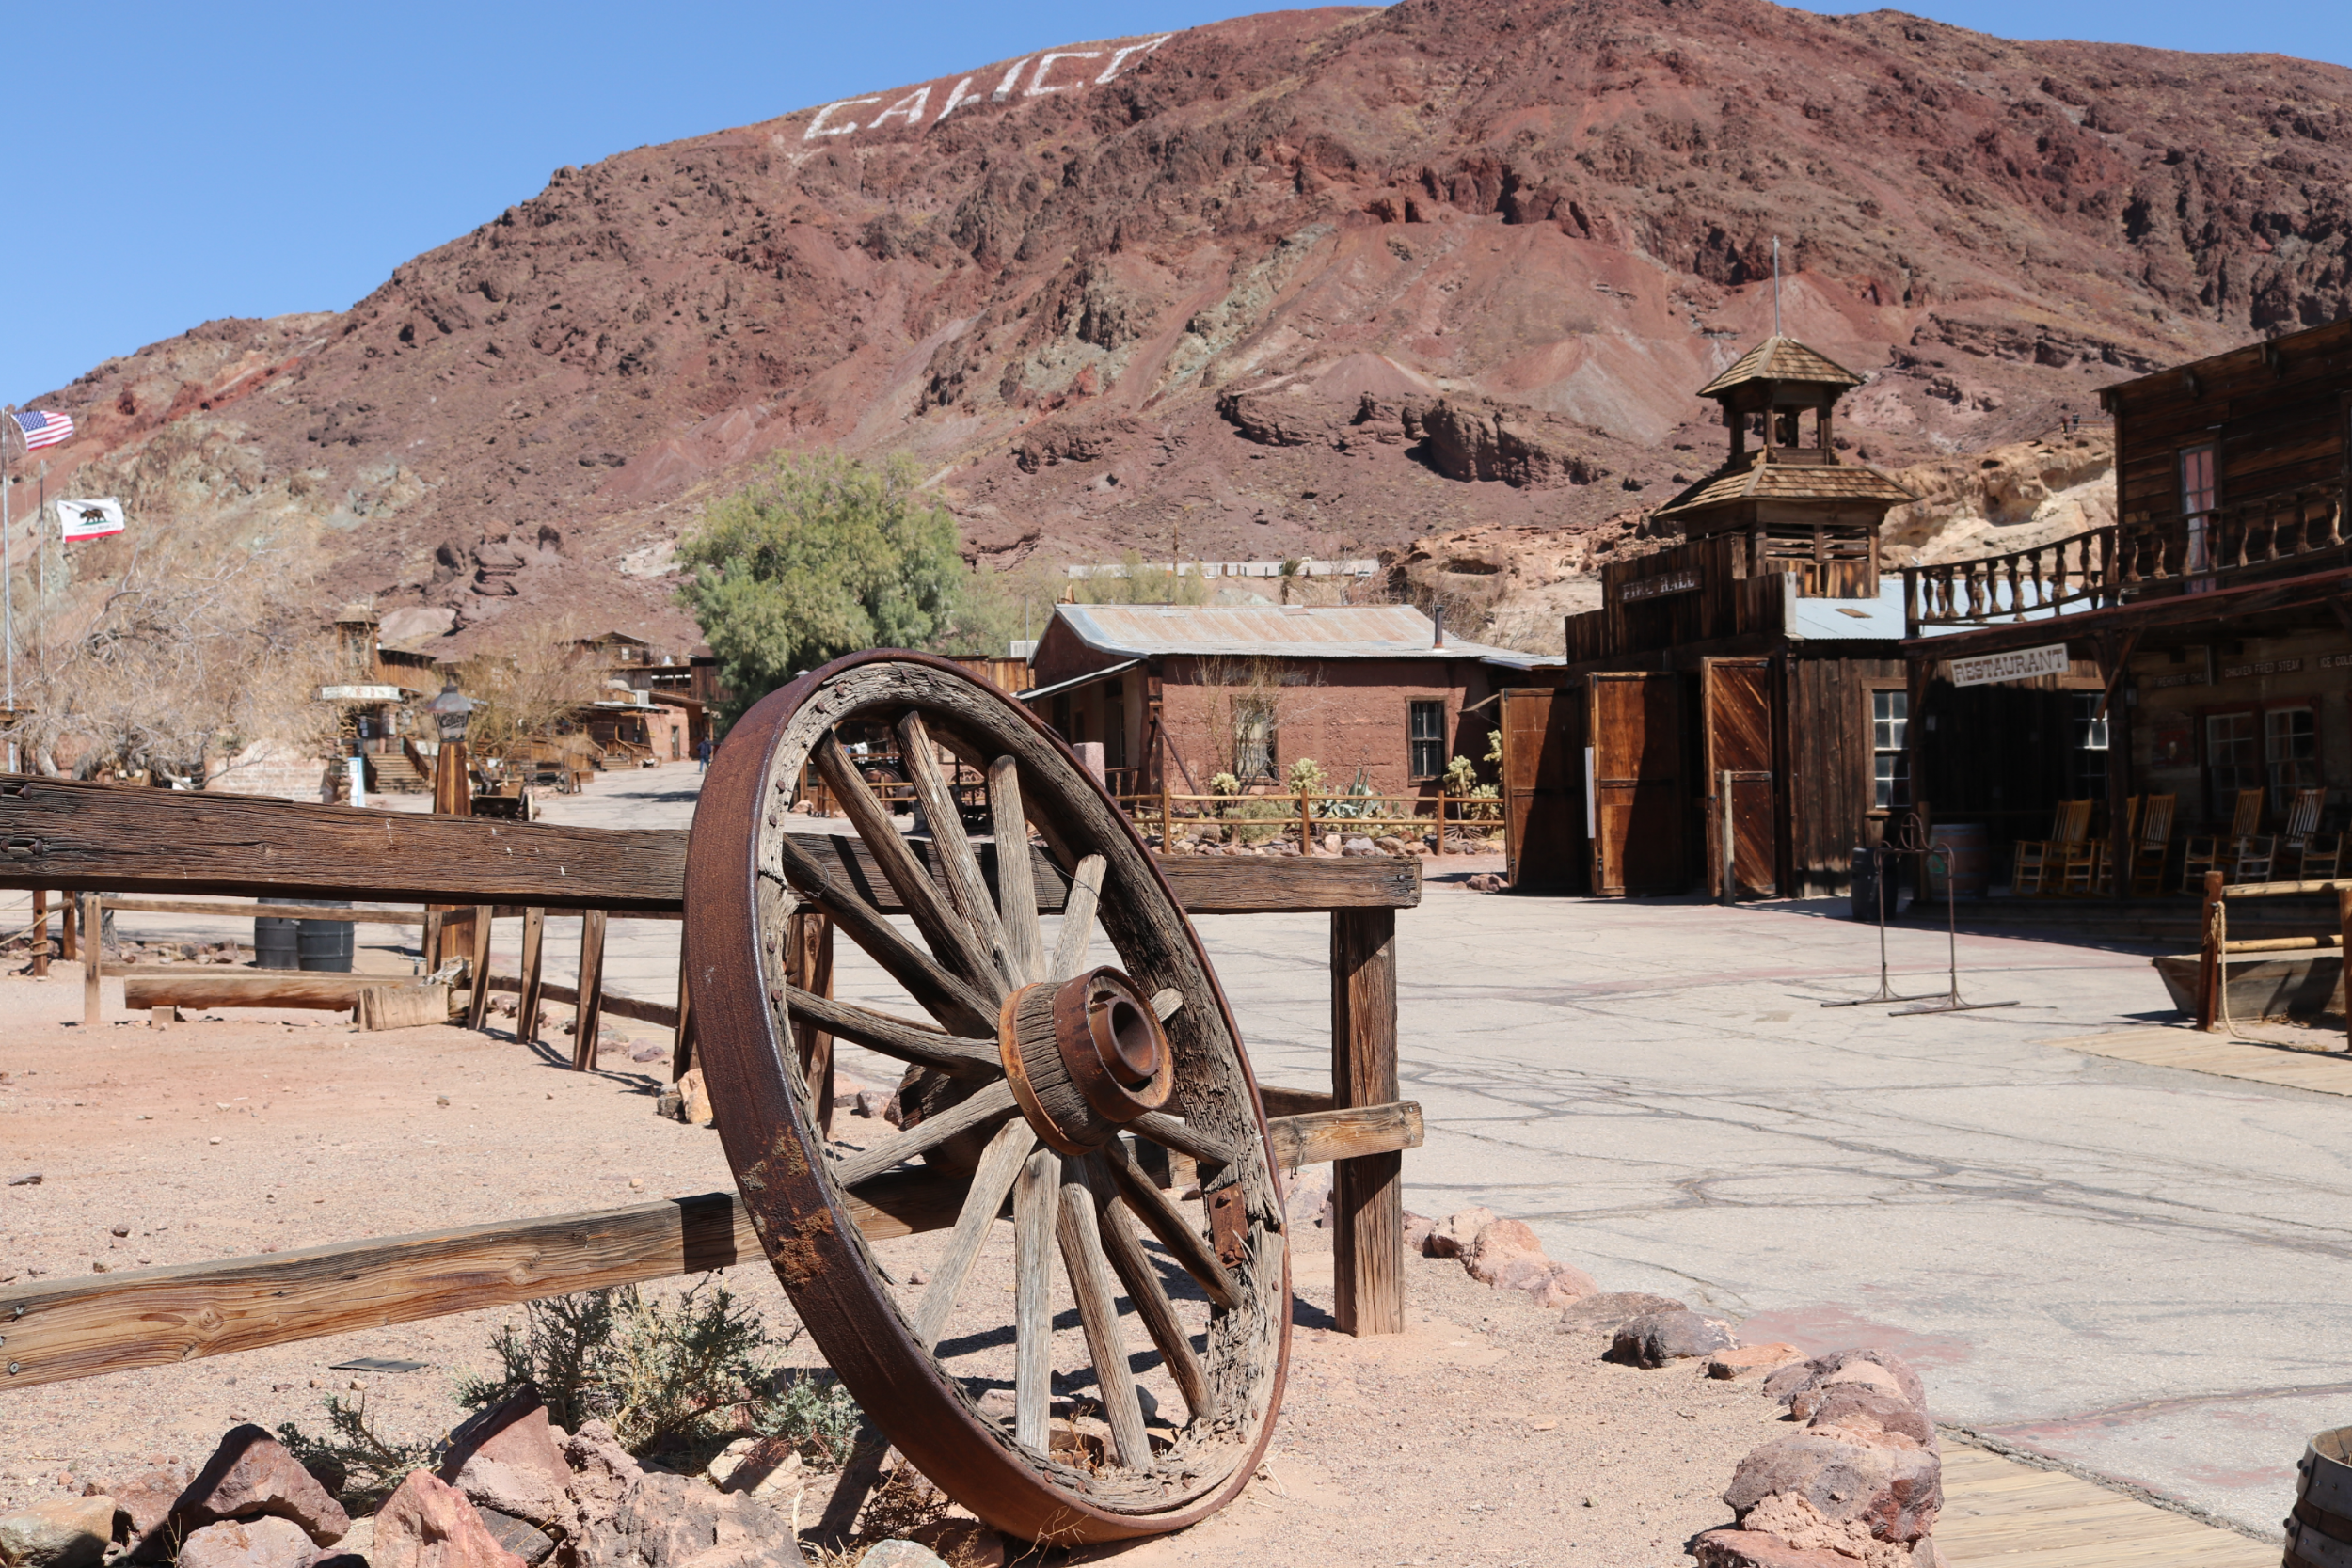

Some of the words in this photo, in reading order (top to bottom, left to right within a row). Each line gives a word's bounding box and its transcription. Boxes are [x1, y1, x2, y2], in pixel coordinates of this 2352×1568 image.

[803, 34, 1173, 141] CALICO
[1622, 580, 1654, 601] FIRE
[1953, 649, 2063, 683] RESTAURANT
[2224, 665, 2252, 678] CHICKEN
[2254, 662, 2275, 674] FRIED
[2278, 659, 2301, 672] STEAK
[2320, 657, 2332, 669] ICE
[2153, 673, 2187, 687] FIREHOUSE
